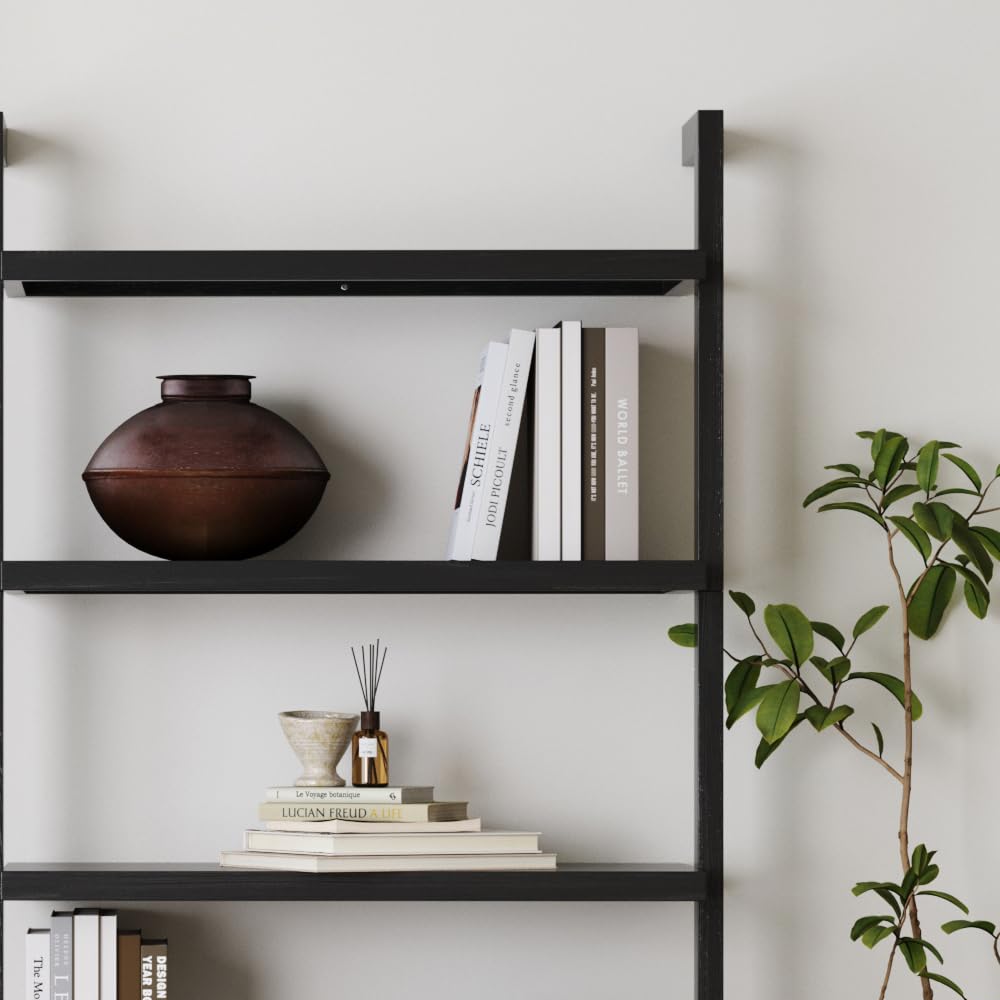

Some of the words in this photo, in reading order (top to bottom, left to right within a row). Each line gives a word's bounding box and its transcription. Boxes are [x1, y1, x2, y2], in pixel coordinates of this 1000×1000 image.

[511, 362, 520, 393] glance
[504, 395, 515, 427] second
[616, 398, 628, 445] WORLD
[471, 423, 491, 487] SCHIELE
[491, 449, 508, 497] PICOULT
[616, 451, 628, 495] BALLET
[485, 498, 498, 527] JODI
[305, 791, 327, 800] Voyage
[329, 791, 361, 800] botanique
[282, 807, 325, 818] LUCIAN
[329, 807, 367, 818] FREUD
[33, 957, 44, 978] The
[142, 956, 153, 986] YEAR
[156, 956, 167, 999] DESIGN
